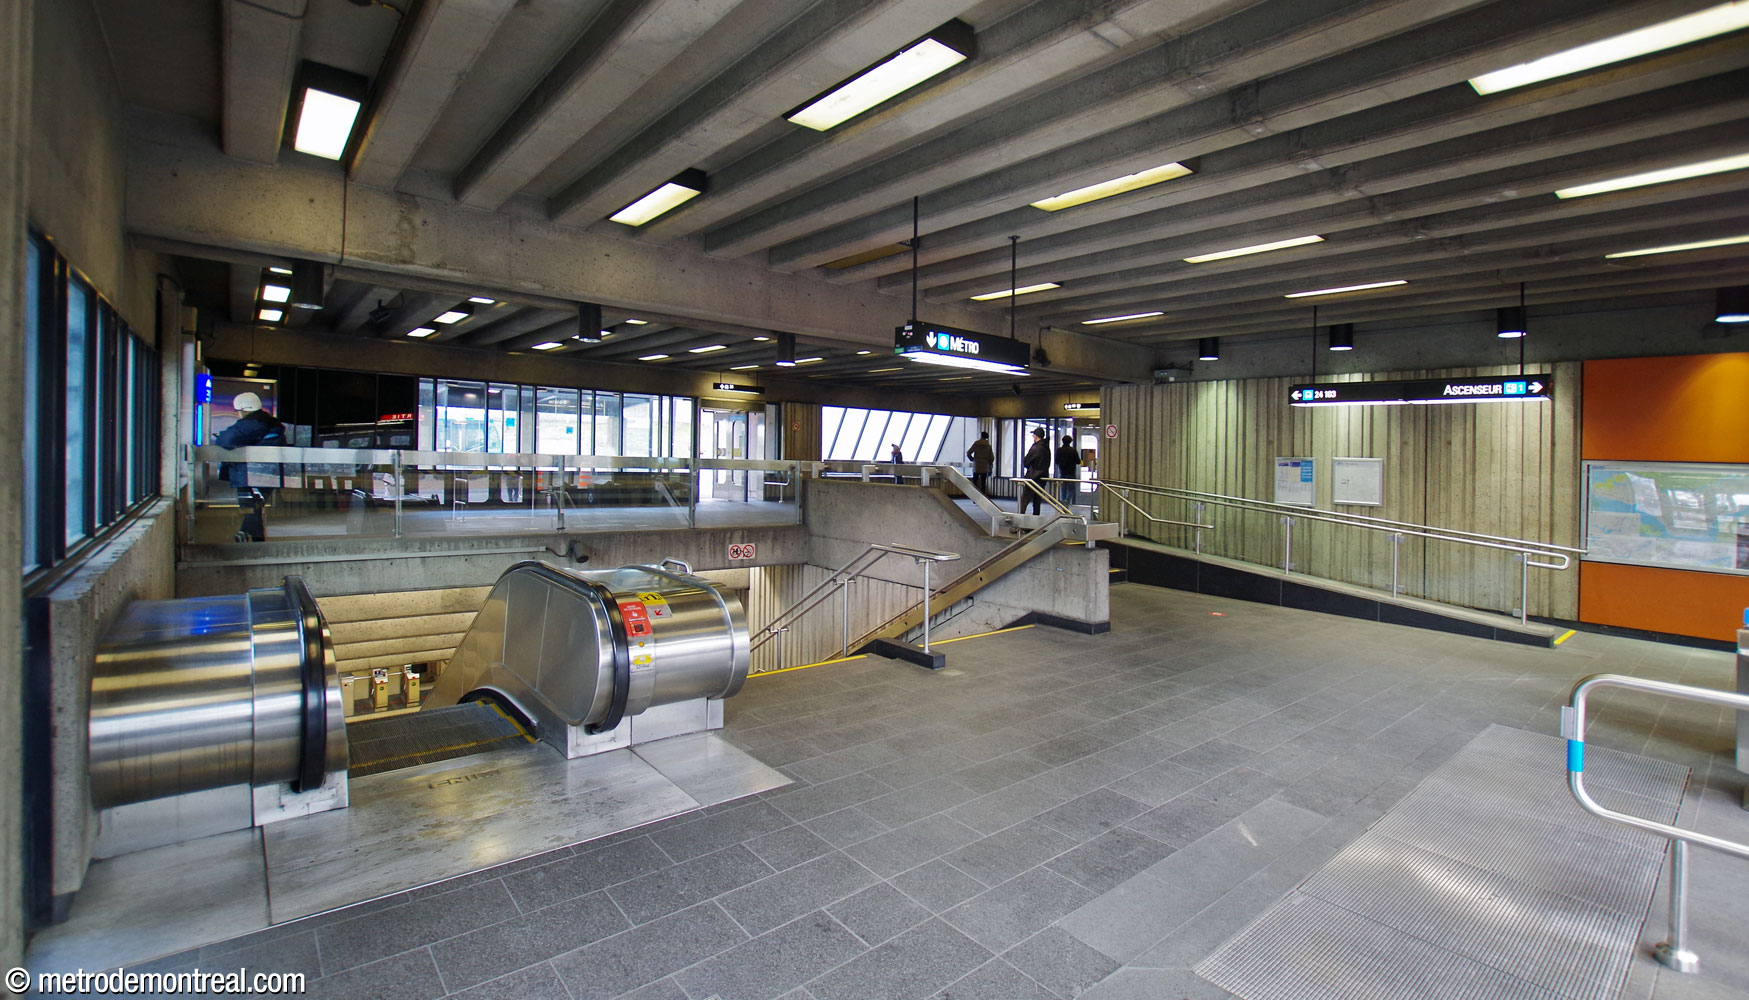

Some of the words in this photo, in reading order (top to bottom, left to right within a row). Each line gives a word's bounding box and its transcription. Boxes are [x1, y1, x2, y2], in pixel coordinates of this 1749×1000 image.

[950, 336, 979, 354] MÉTRO
[1314, 390, 1323, 398] 24
[1324, 390, 1337, 398] 103
[1443, 384, 1502, 395] ASCENSEUR
